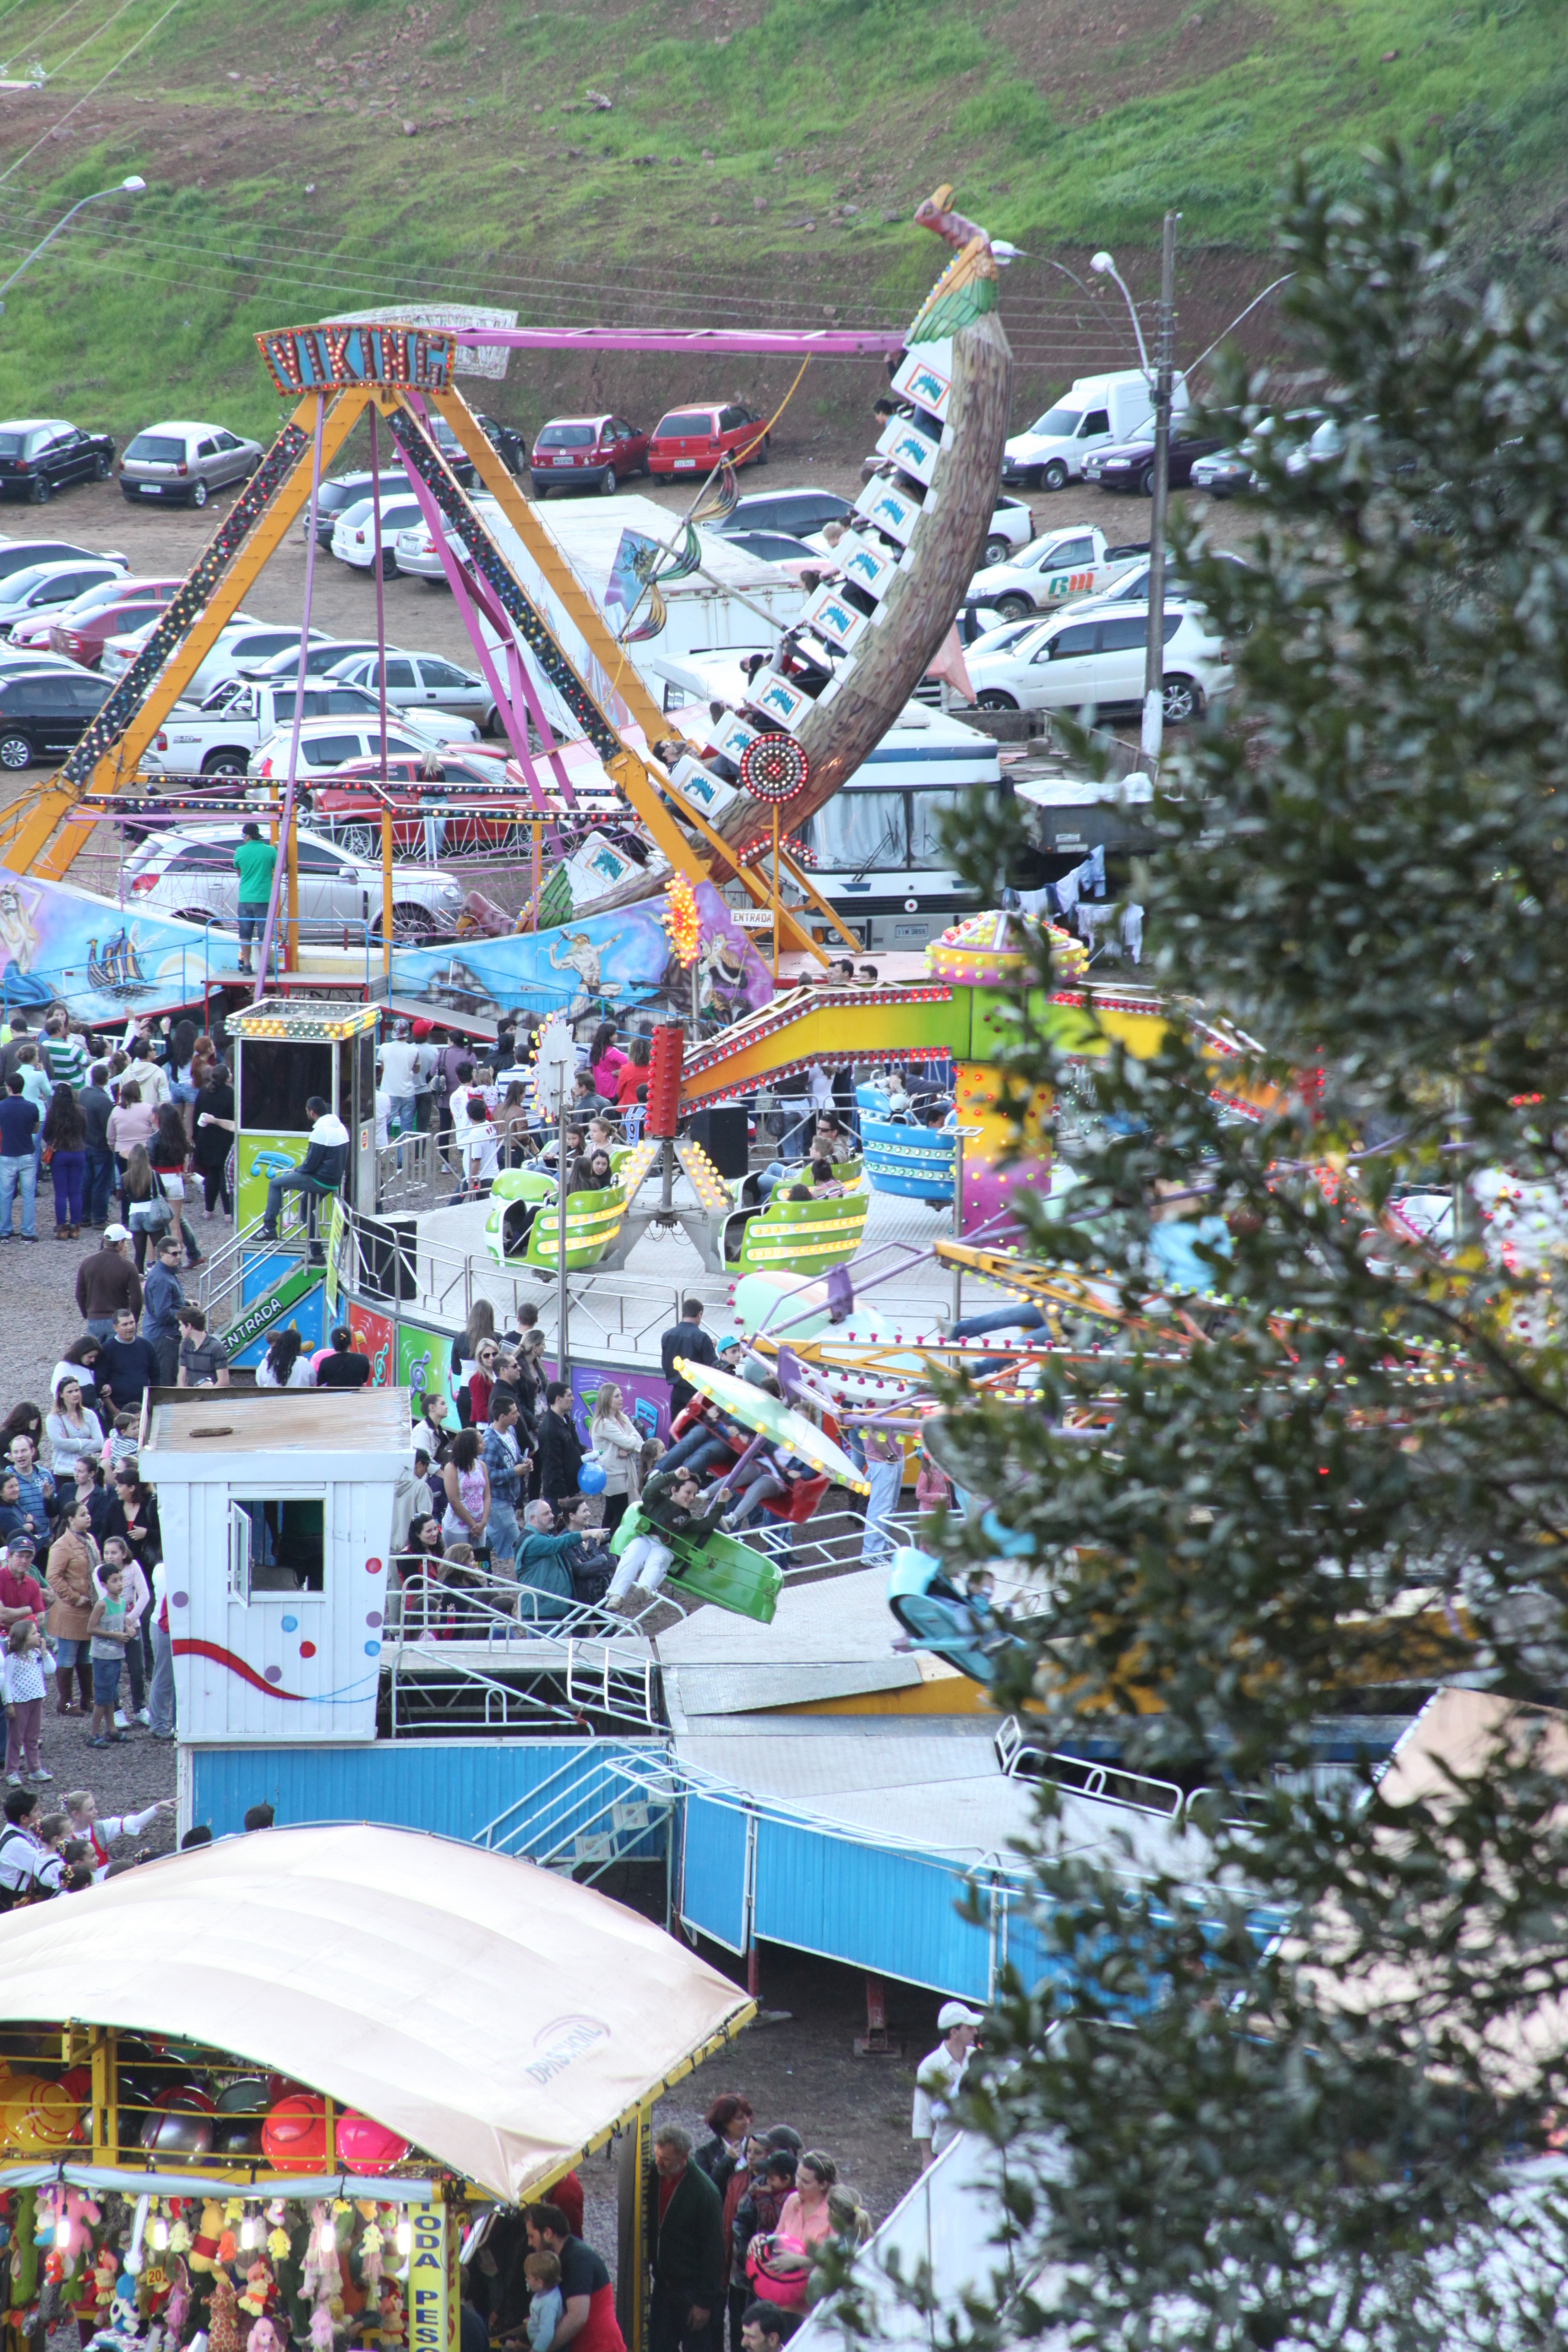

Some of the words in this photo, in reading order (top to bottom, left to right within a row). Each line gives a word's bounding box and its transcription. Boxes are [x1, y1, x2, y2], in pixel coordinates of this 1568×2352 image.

[267, 330, 445, 386] VIKING
[733, 912, 772, 923] ENTRADA
[149, 2270, 161, 2284] 20
